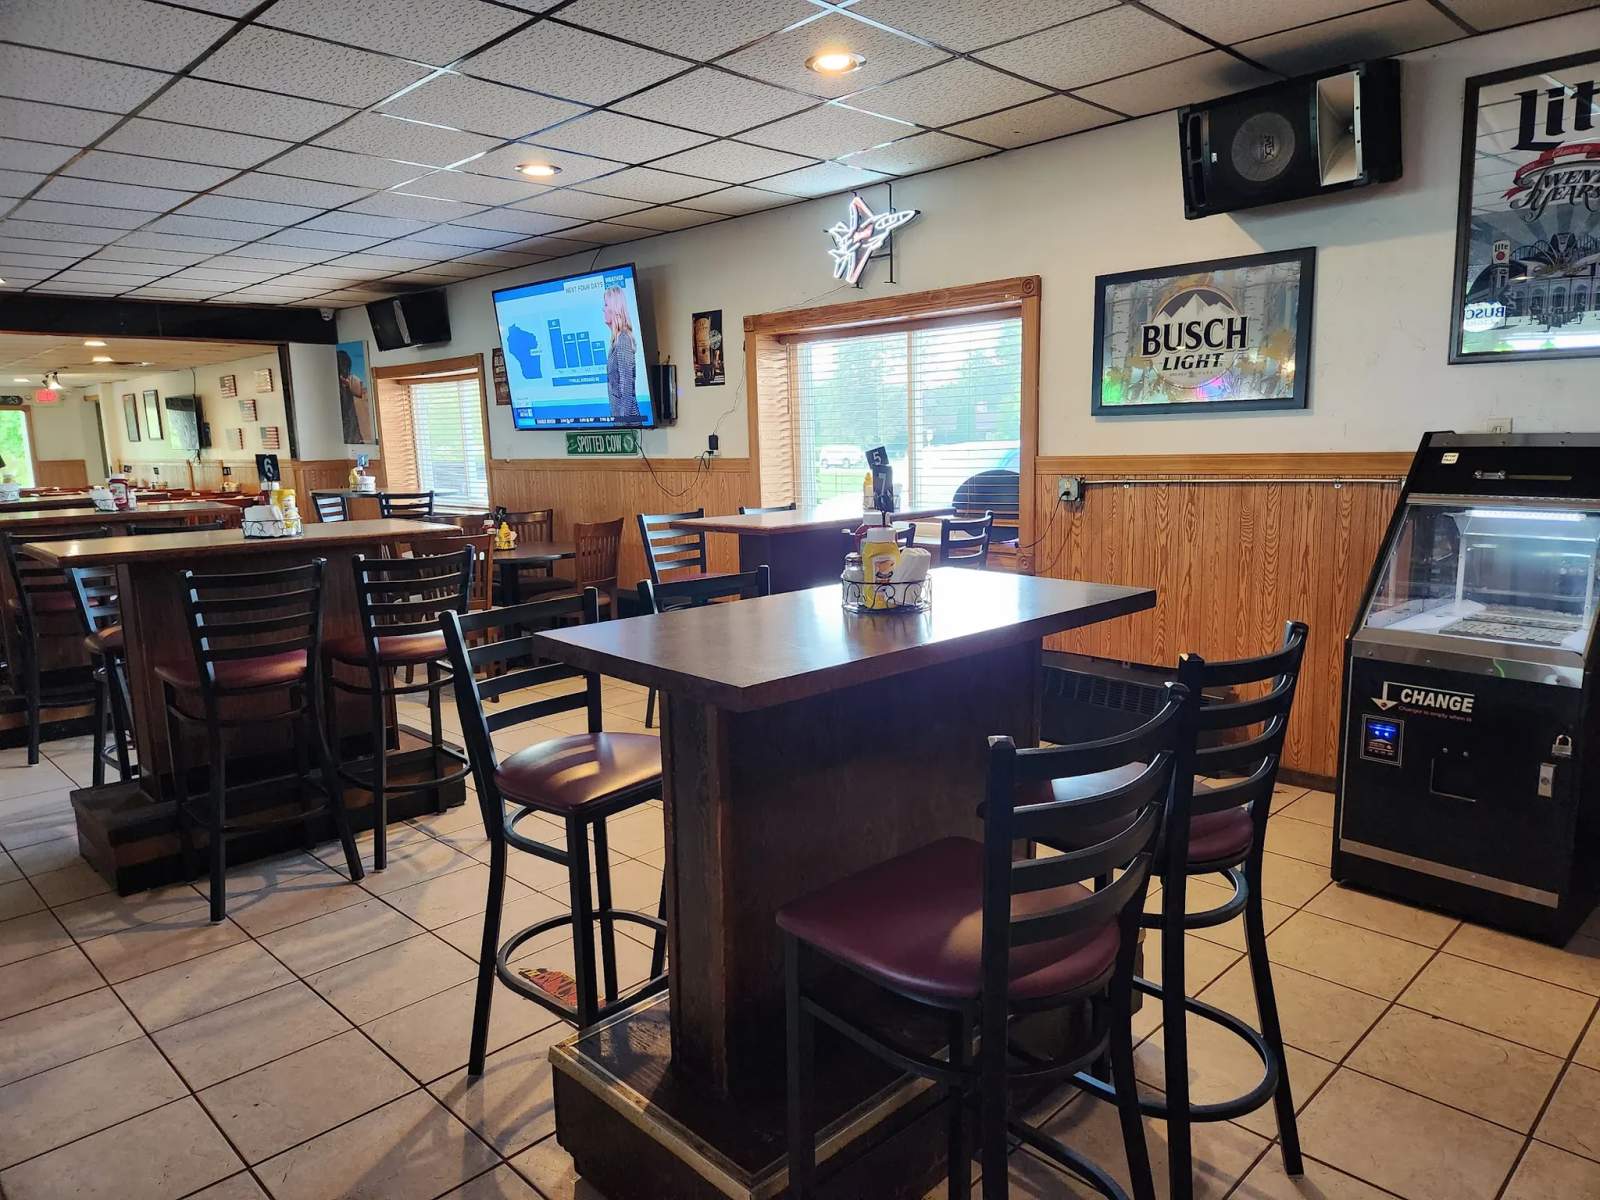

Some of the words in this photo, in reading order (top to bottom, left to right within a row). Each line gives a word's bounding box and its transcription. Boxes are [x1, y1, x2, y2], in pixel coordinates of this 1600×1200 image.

[1494, 242, 1509, 252] Lite
[590, 281, 603, 289] DAYS
[1141, 316, 1248, 356] BUSCH
[1162, 352, 1224, 371] LIGHT
[576, 434, 604, 453] SPOTTED
[605, 433, 622, 453] COW
[263, 458, 274, 477] 6
[872, 451, 882, 466] 5
[878, 472, 887, 493] 7
[1401, 688, 1475, 714] CHANGE
